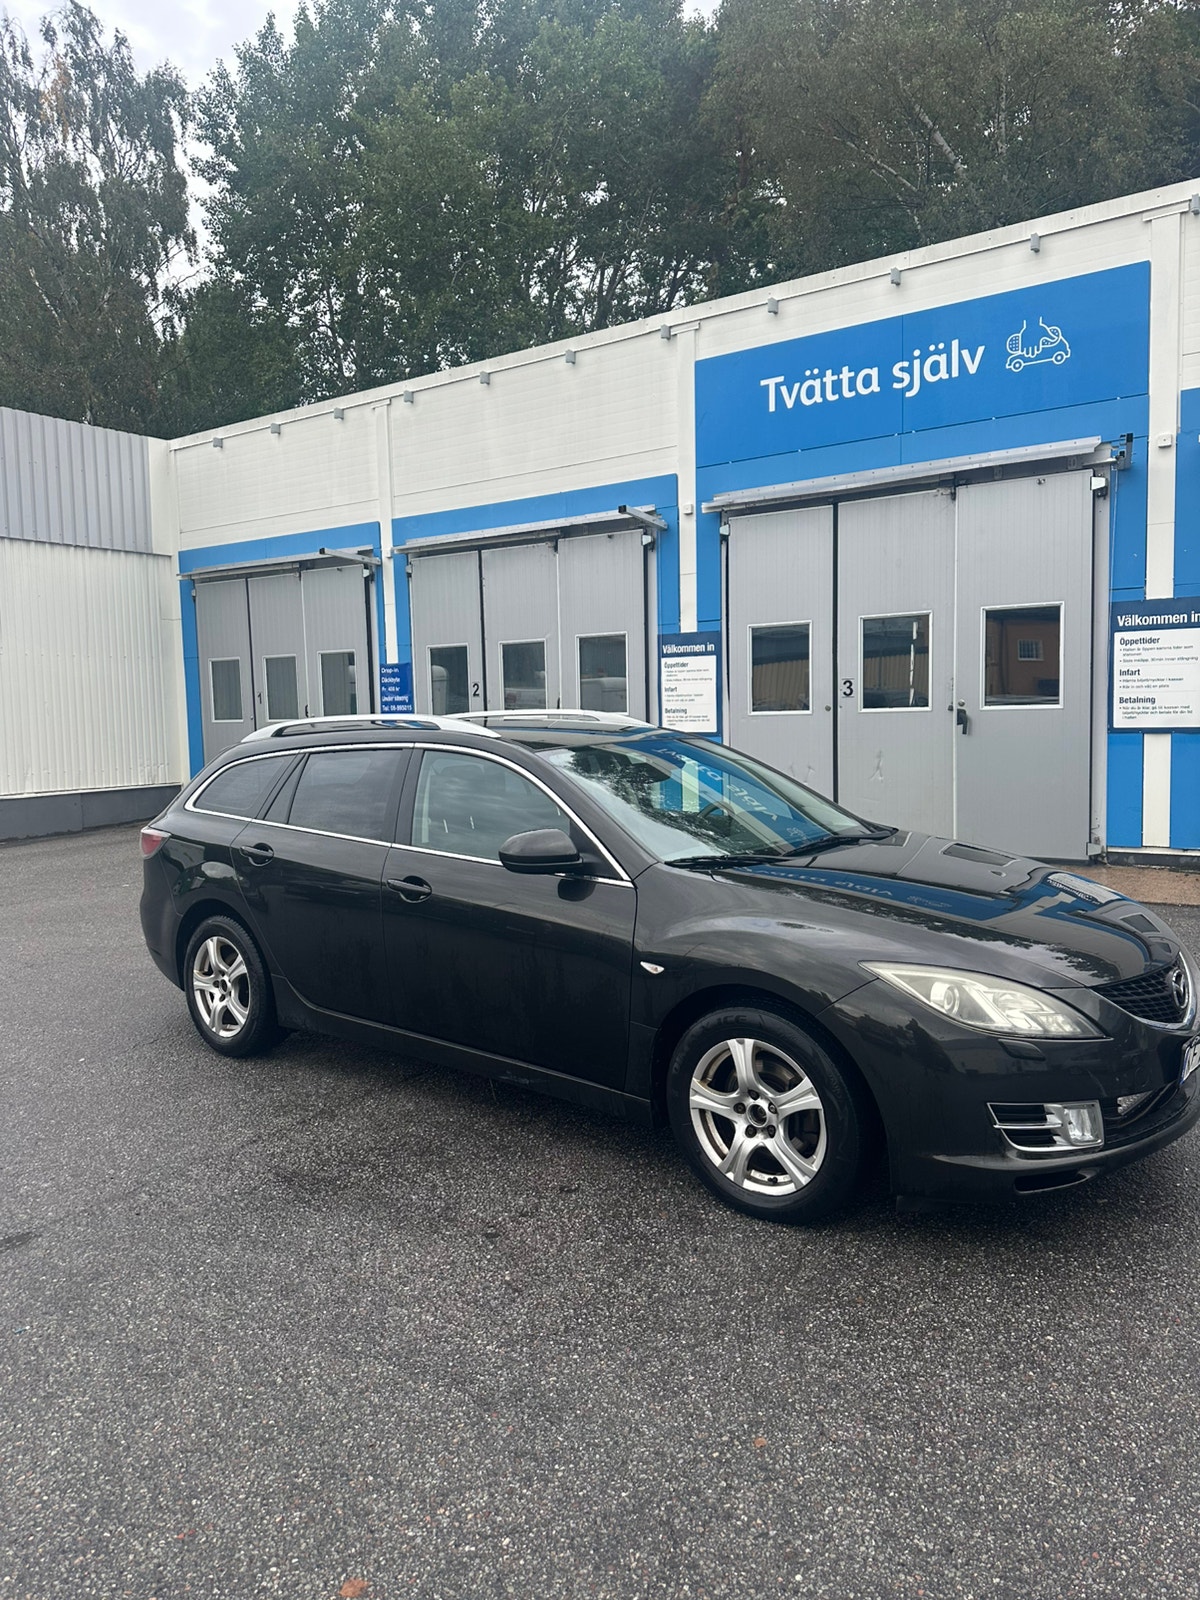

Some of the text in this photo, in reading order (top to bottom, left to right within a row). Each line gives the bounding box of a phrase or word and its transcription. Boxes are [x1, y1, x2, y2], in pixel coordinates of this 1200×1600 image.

[760, 338, 986, 412] Tvätta själv
[1117, 613, 1188, 627] Välkommen
[663, 642, 715, 654] Välkommen in
[1120, 637, 1160, 646] Öppettider
[472, 683, 480, 697] 2
[843, 680, 853, 697] 3
[257, 692, 262, 704] 1
[1119, 696, 1156, 704] Betalning
